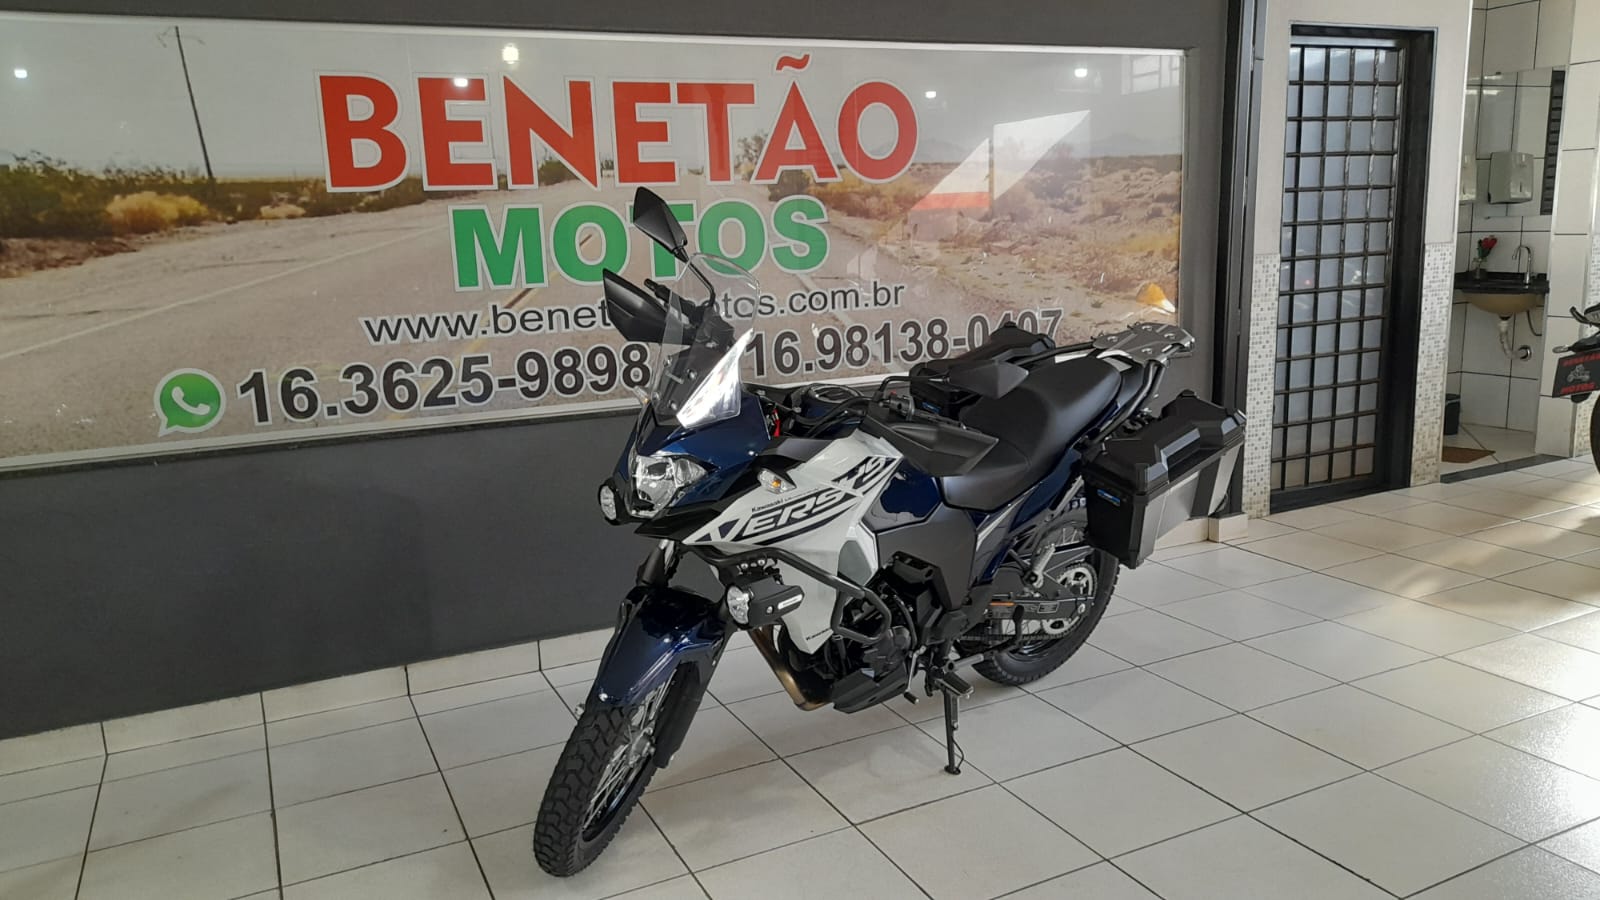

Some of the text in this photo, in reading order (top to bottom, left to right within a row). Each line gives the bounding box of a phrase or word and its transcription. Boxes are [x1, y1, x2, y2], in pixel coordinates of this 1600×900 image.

[318, 53, 919, 189] BENETÃO
[452, 193, 829, 287] MOTOS
[365, 282, 904, 342] www.benettos.com.br
[238, 342, 650, 425] 16.3625-9898
